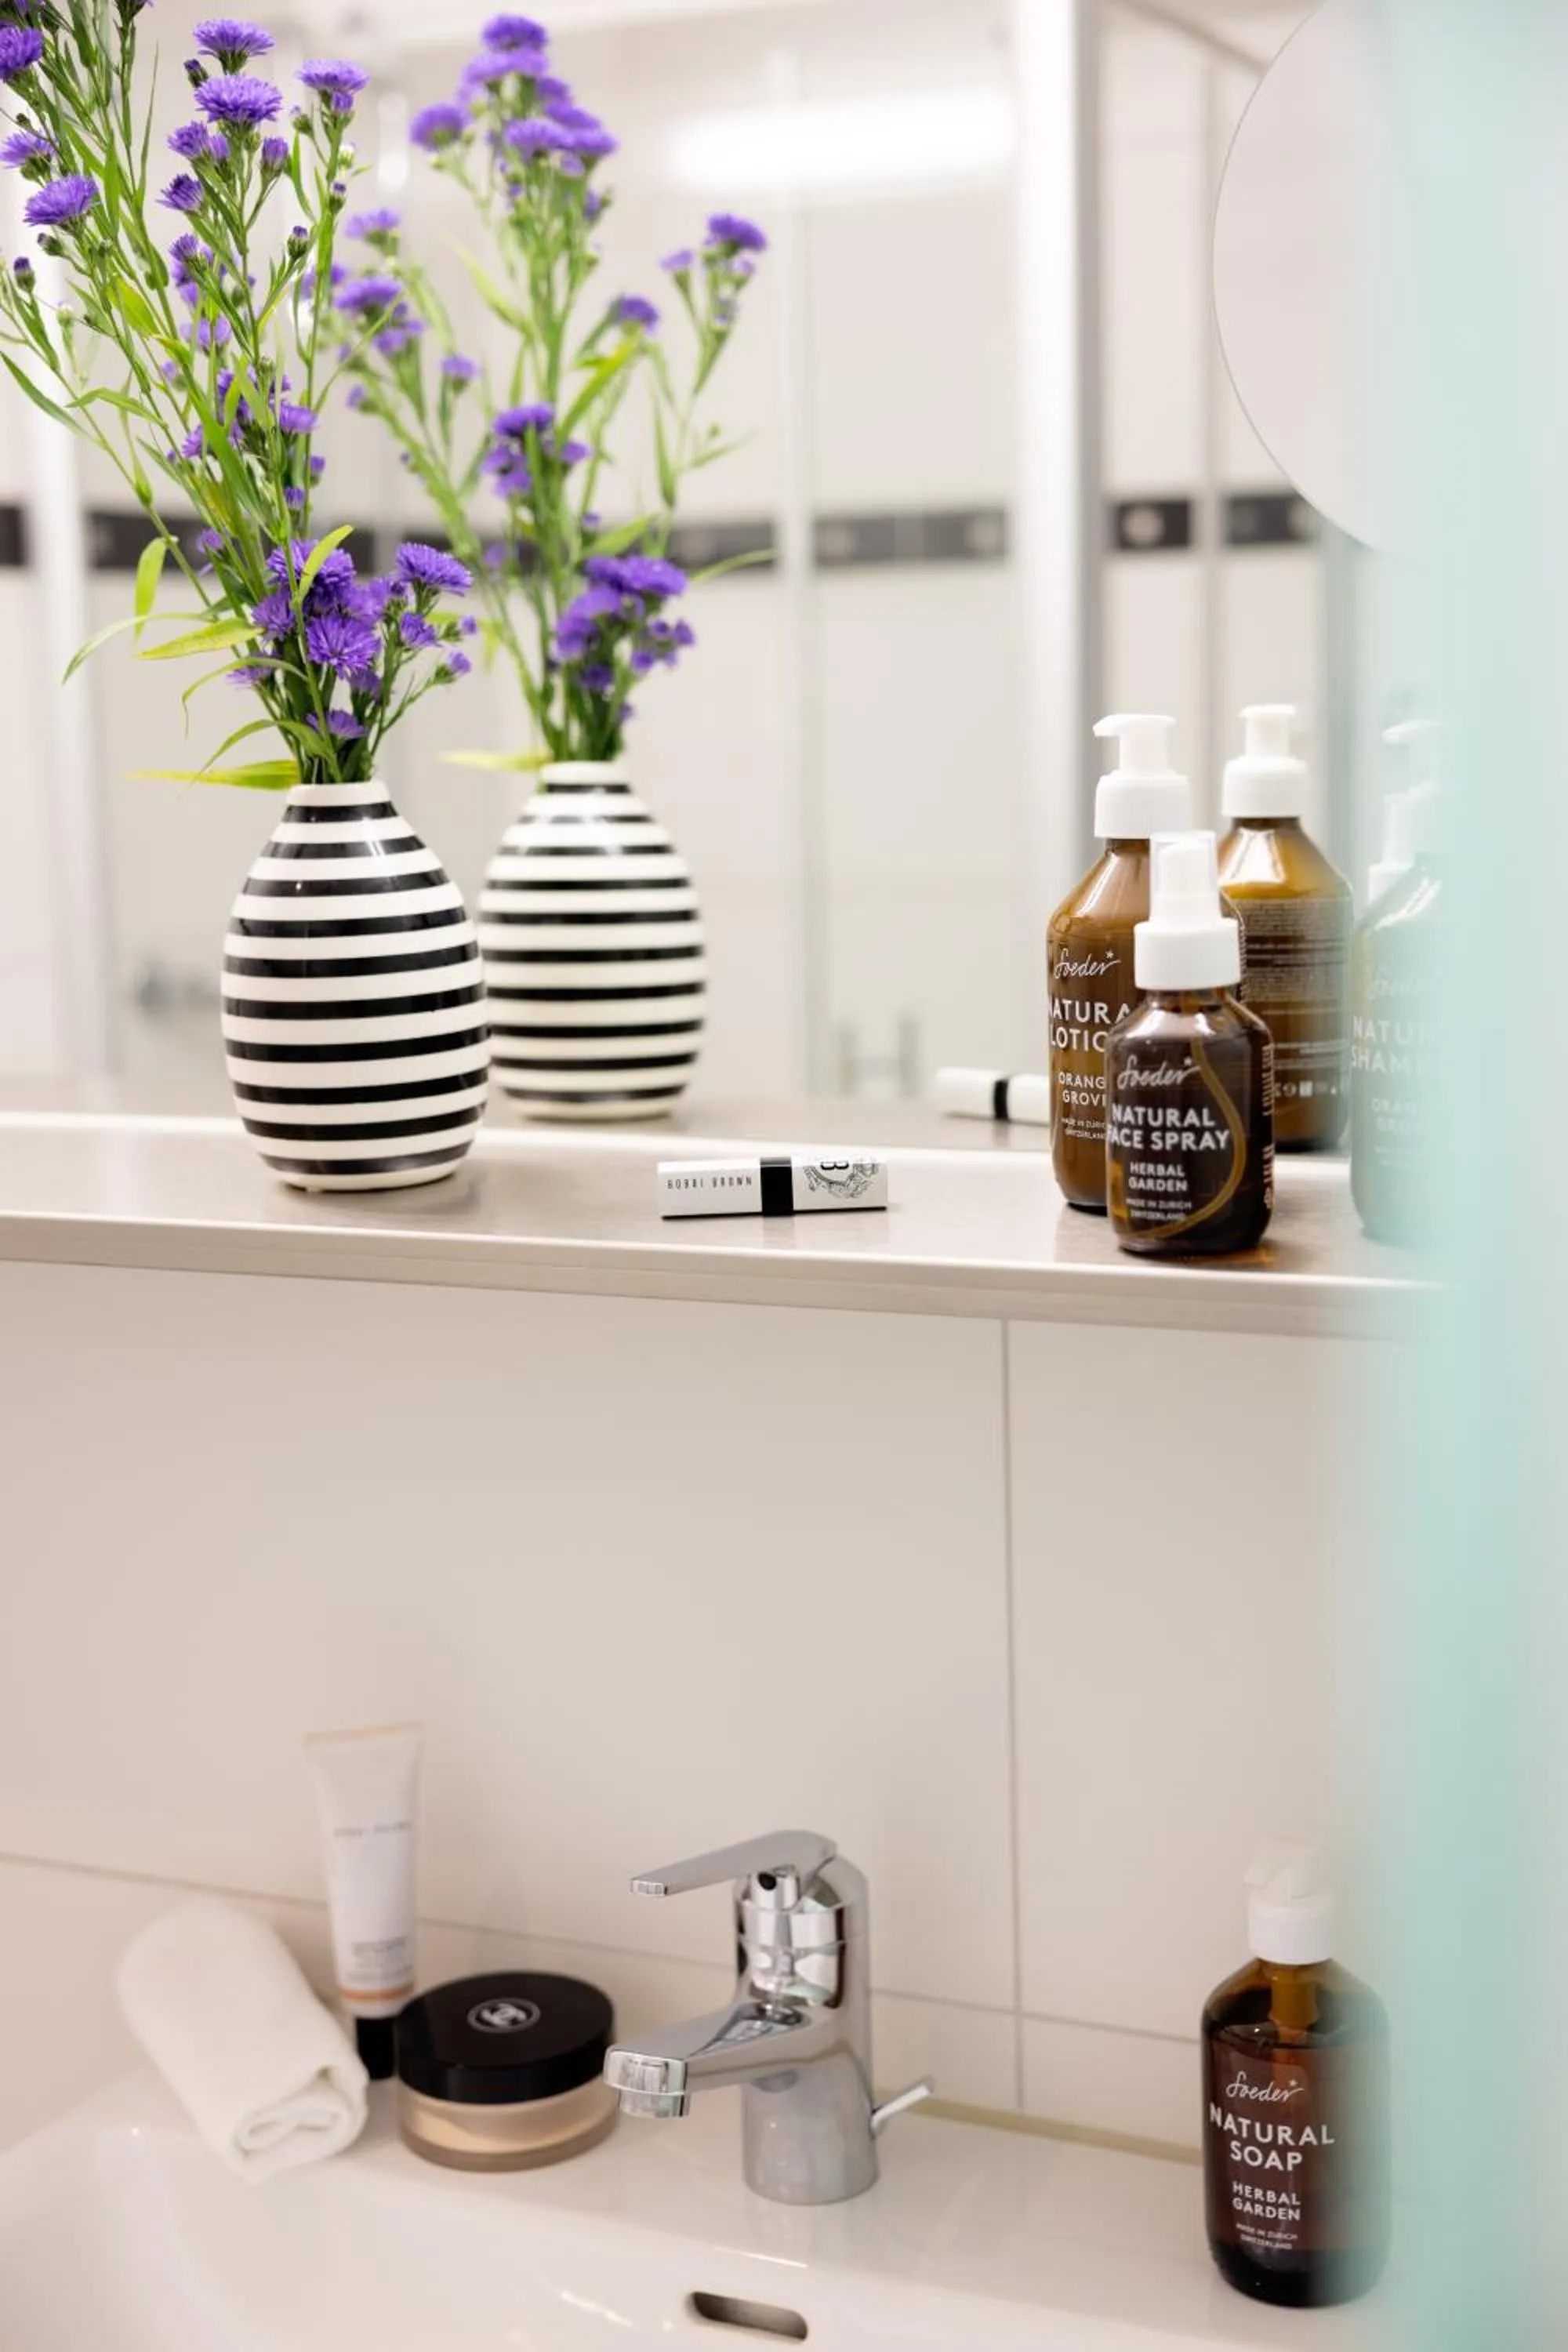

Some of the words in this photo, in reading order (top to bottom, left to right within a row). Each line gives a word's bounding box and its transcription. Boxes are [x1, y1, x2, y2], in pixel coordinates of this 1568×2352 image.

[1051, 1025, 1107, 1052] LOTIO
[1058, 1071, 1106, 1090] ORANG
[1112, 1104, 1214, 1127] NATURAL
[1150, 1130, 1230, 1151] SPRAY
[1130, 1161, 1185, 1177] HERBAL
[1128, 1177, 1188, 1192] GARDEN
[1209, 2101, 1335, 2146] NATURAL
[1229, 2140, 1303, 2171] SOAP
[1232, 2180, 1301, 2205] HERBAL
[1232, 2197, 1301, 2221] GARDEN
